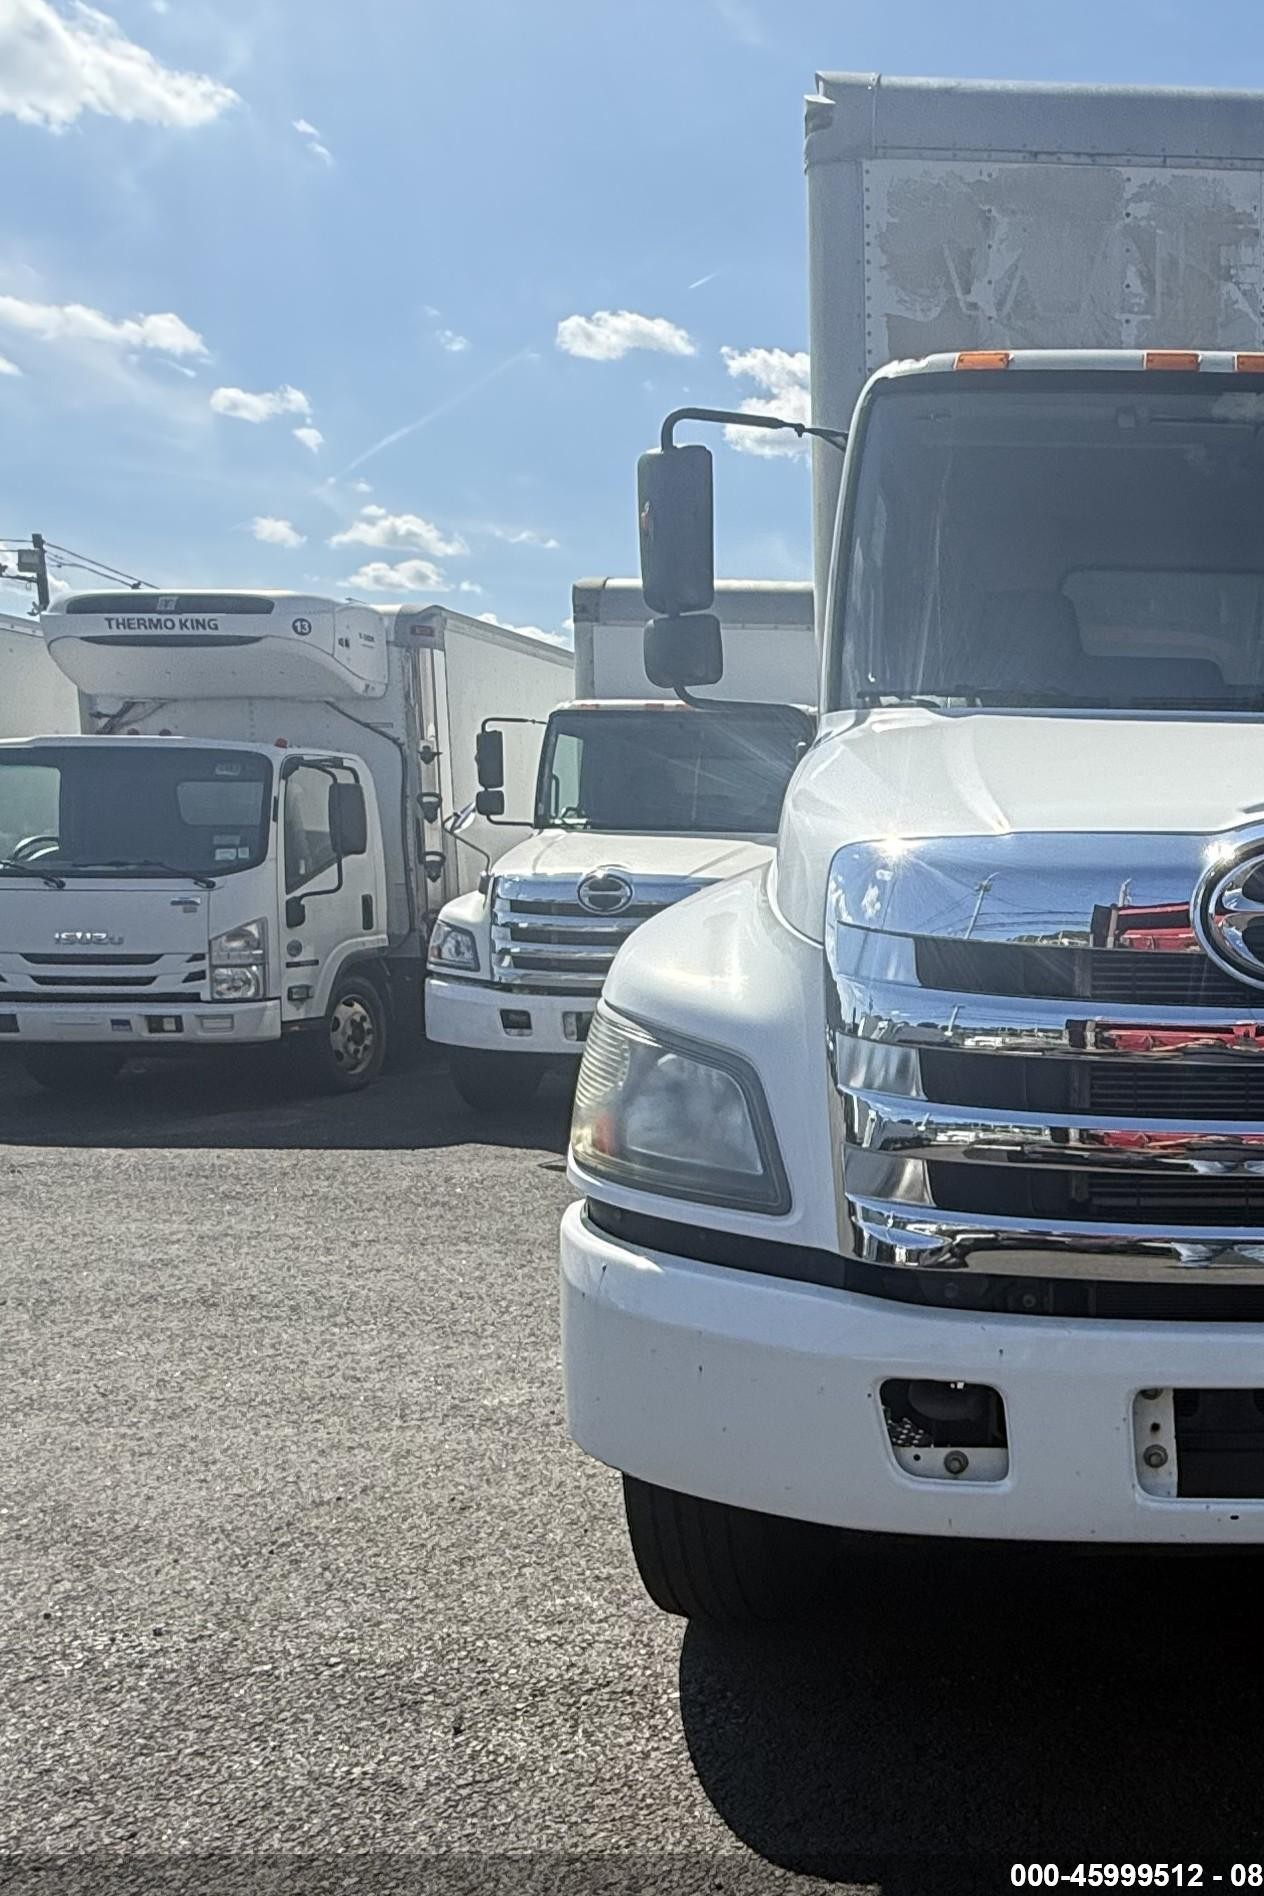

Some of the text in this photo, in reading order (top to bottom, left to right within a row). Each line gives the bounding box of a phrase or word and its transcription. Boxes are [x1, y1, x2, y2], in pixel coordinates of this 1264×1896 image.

[104, 617, 219, 631] THERMO KING
[294, 620, 310, 633] 13
[54, 931, 125, 945] ISUZU
